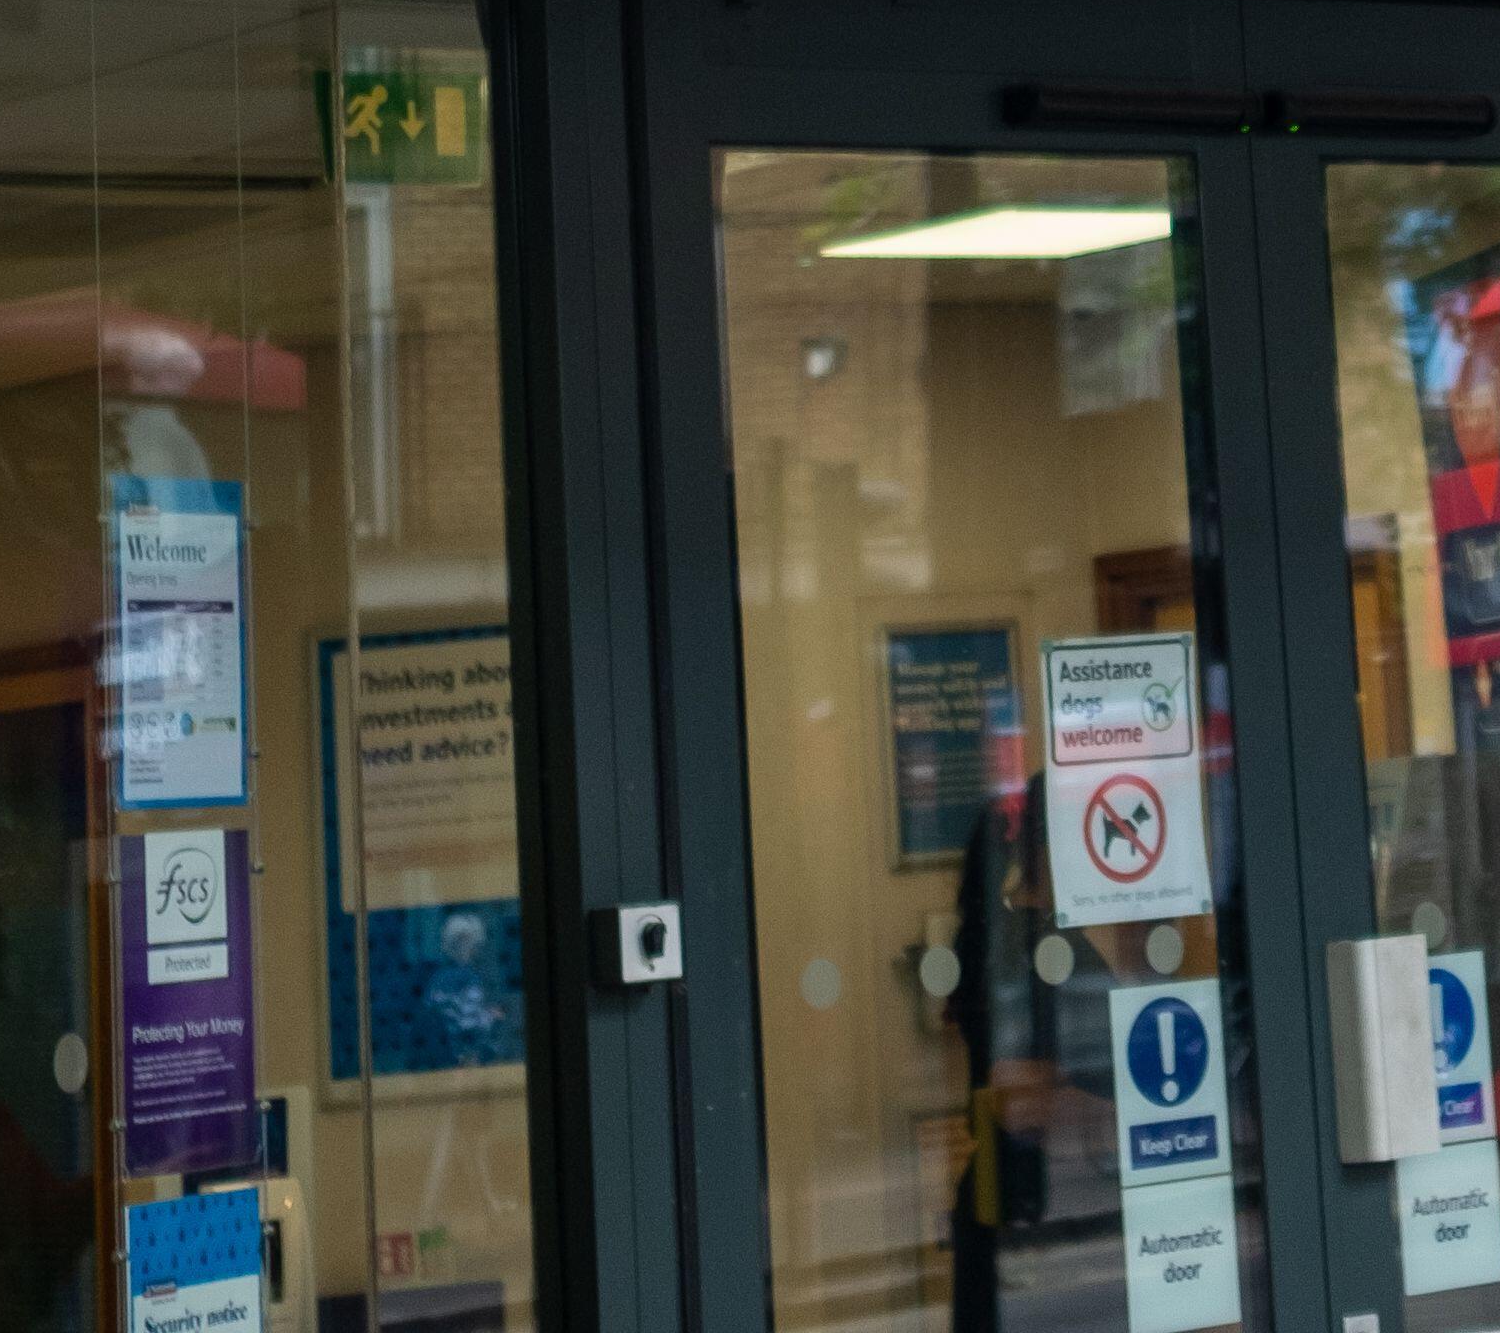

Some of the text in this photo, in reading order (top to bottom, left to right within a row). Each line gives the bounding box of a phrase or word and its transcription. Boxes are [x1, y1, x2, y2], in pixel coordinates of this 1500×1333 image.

[126, 534, 208, 564] Welcome
[461, 662, 511, 683] abo
[1060, 659, 1153, 683] Assistance
[360, 700, 497, 730] nvestments
[1060, 692, 1102, 719] dogs
[420, 731, 508, 763] advice?
[1062, 724, 1143, 748] welcome
[164, 954, 211, 973] Protected
[132, 1018, 245, 1044] Protecting Your Money
[1444, 1098, 1476, 1116] Clear
[1140, 1128, 1209, 1157] Keep Clear
[1412, 1187, 1489, 1218] Automatic
[1138, 1225, 1224, 1258] Automatic
[1435, 1220, 1472, 1243] door
[1163, 1260, 1203, 1284] door
[143, 1299, 248, 1333] Security notice
